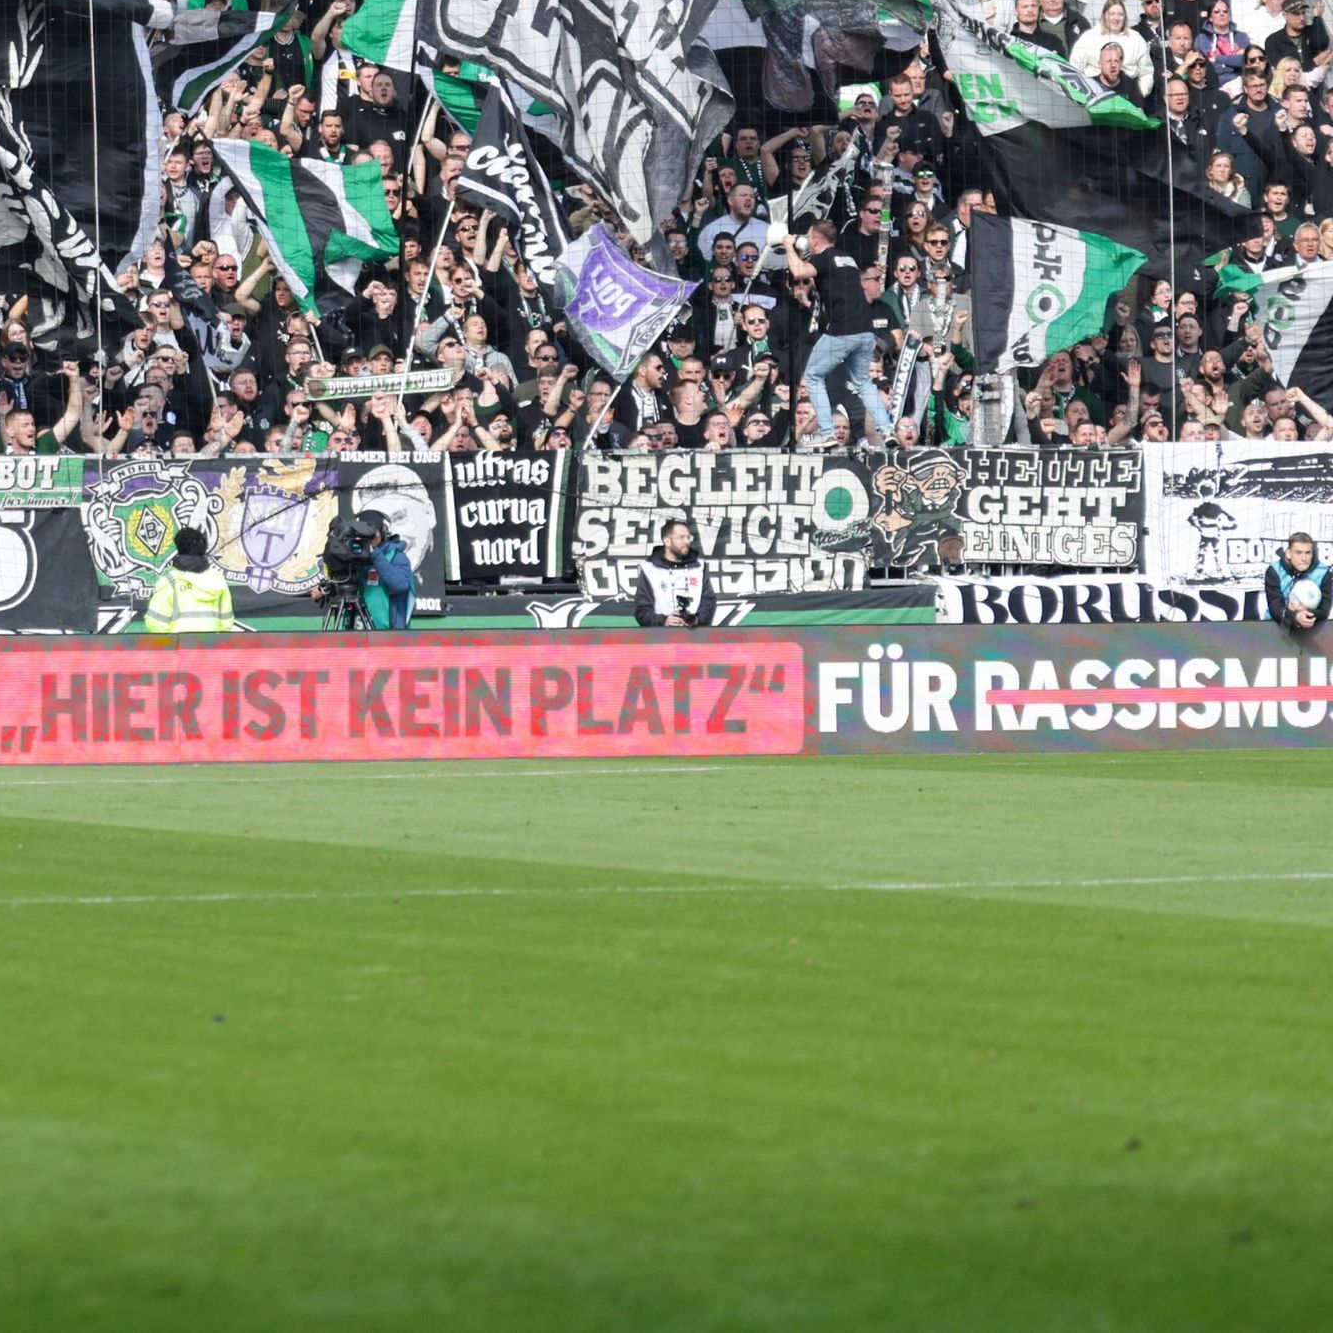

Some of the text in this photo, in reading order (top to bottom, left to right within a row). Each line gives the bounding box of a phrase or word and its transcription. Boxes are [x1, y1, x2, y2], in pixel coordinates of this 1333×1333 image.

[116, 463, 159, 478] NORD
[340, 449, 442, 463] IMMER BEI UNS
[454, 450, 550, 488] ultras
[964, 449, 1142, 490] HEUTE
[581, 452, 823, 508] BEGLEIT
[460, 497, 547, 529] curva
[966, 486, 1129, 527] GEHT
[471, 526, 544, 566] nord
[963, 523, 1137, 565] EINIGES
[226, 570, 249, 583] SUD
[960, 582, 1262, 624] BORUSSI
[222, 668, 331, 741] IST
[347, 666, 513, 738] KEIN
[817, 642, 1333, 733] FÜR RASSISMU
